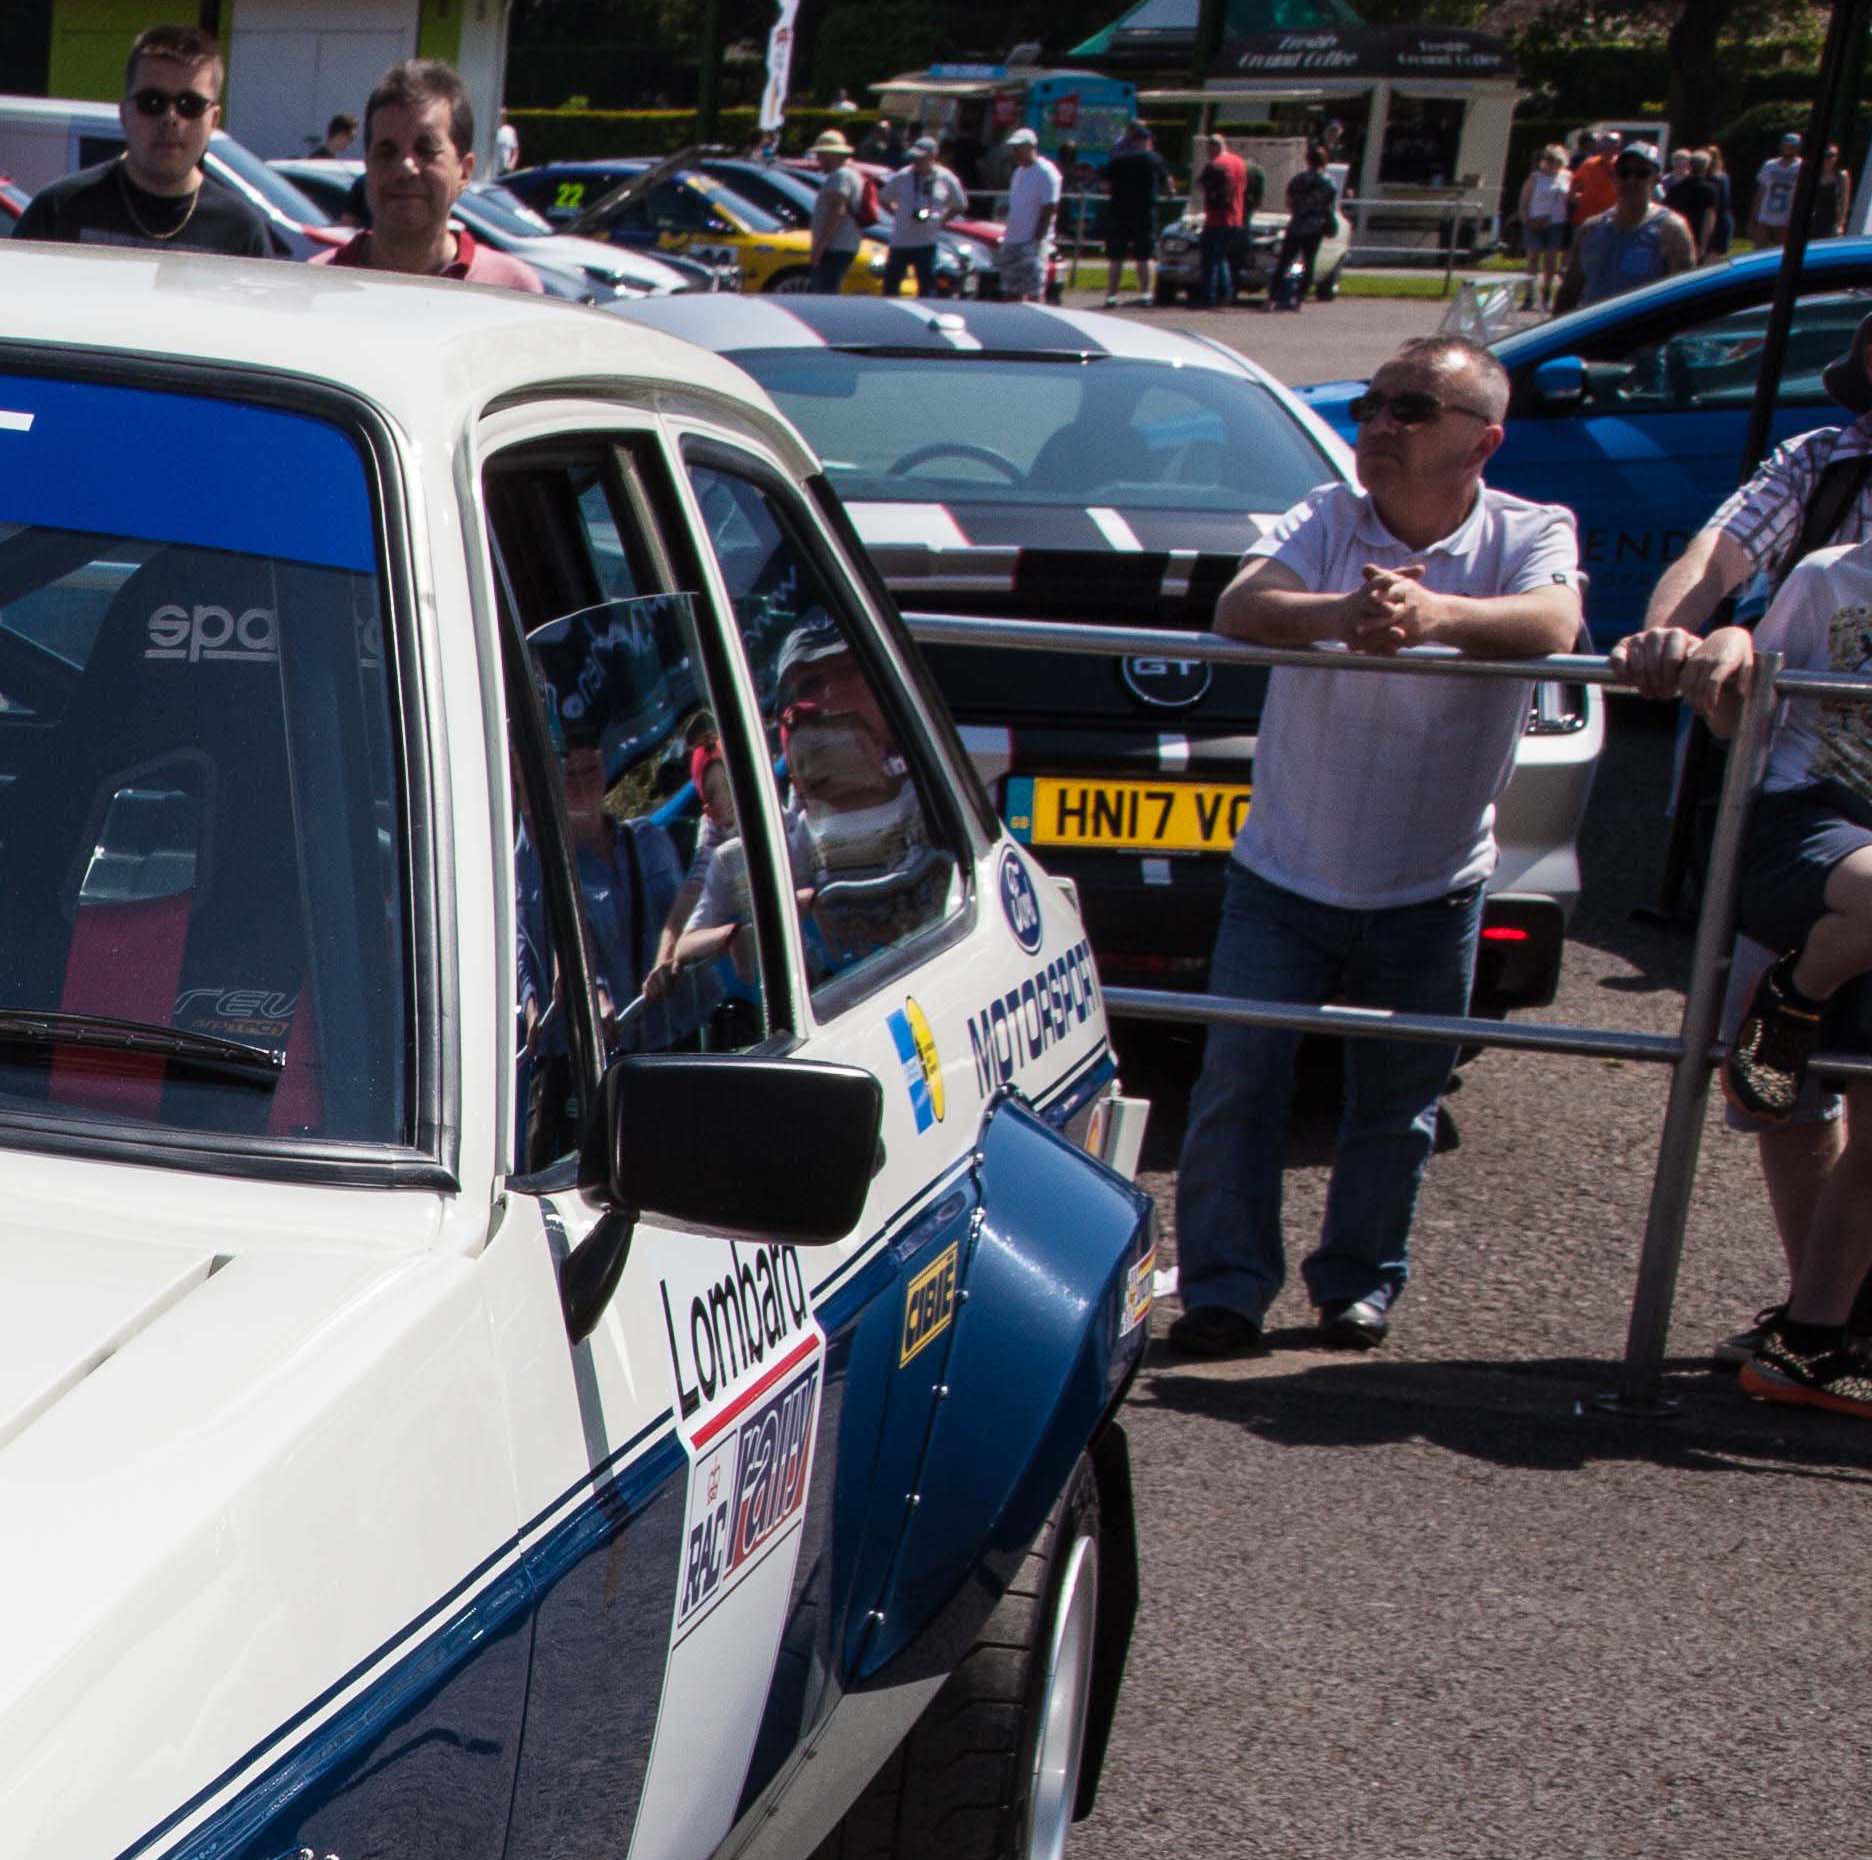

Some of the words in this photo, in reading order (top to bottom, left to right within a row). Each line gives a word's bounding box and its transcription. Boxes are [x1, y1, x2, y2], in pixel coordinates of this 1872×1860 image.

[557, 183, 585, 208] 22
[1132, 657, 1201, 677] GT
[1056, 787, 1176, 839] HN17
[1005, 860, 1039, 937] Ford
[659, 1240, 810, 1422] Lombard
[681, 1500, 728, 1617] RAC
